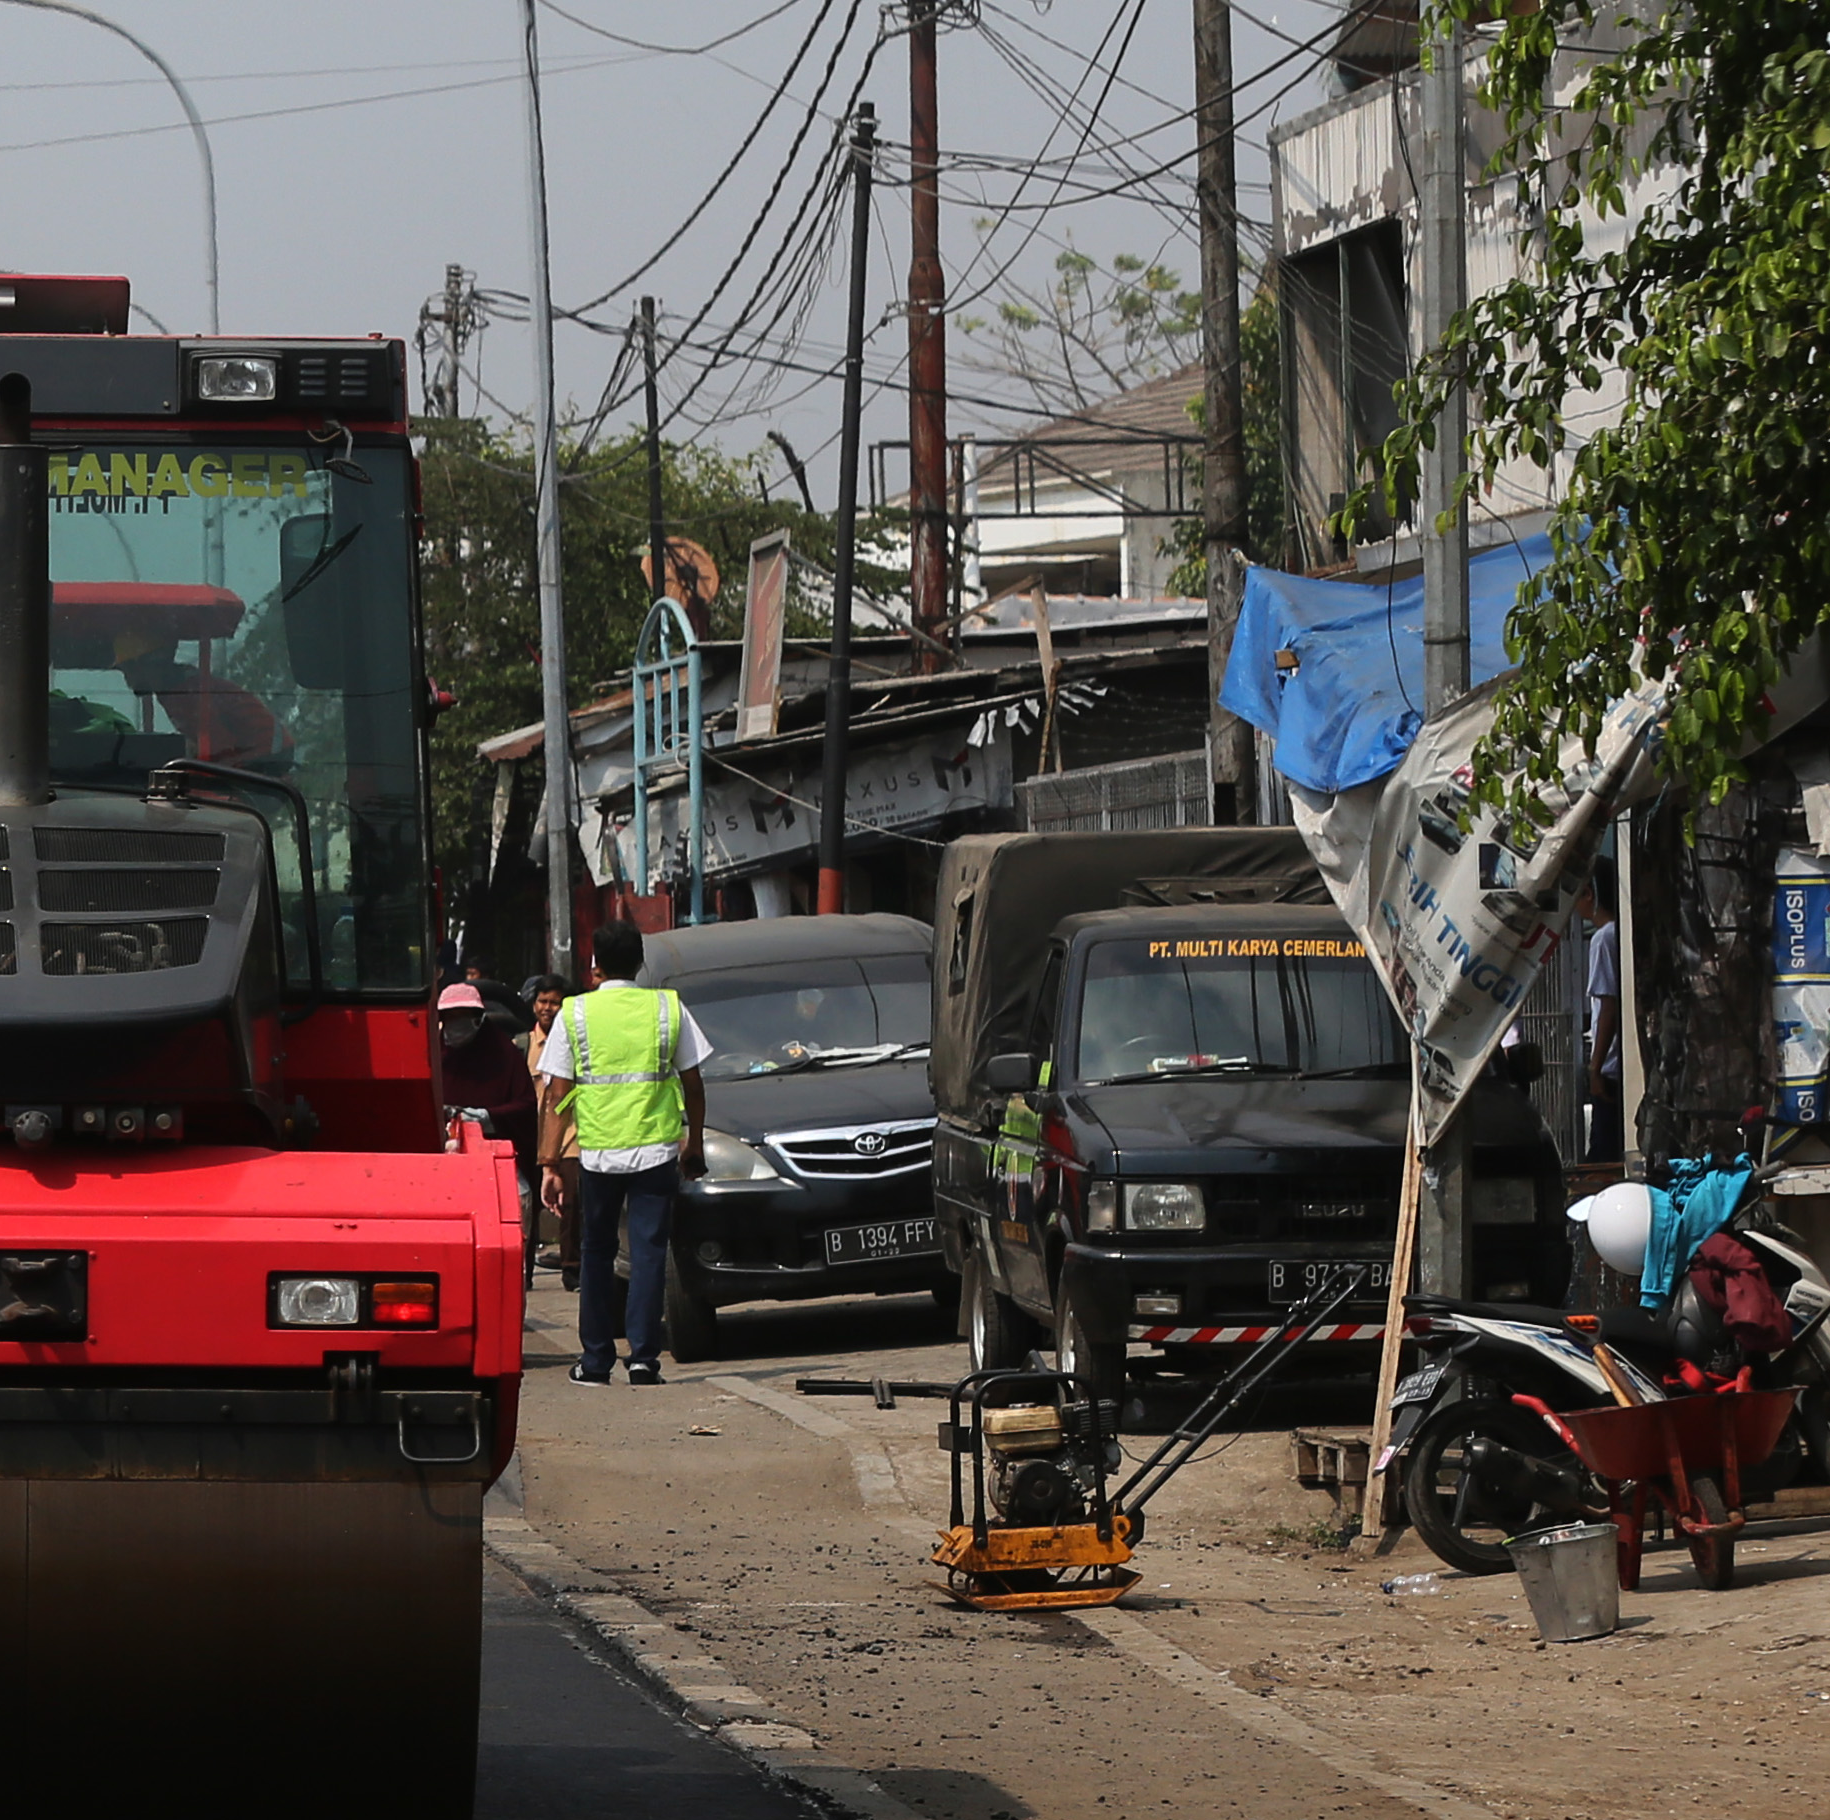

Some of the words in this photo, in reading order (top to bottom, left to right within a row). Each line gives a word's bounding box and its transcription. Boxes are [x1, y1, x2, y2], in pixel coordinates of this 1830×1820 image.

[1786, 889, 1805, 969] ISOPLUS
[1149, 941, 1171, 958] PT.
[1175, 940, 1223, 958] MULTI
[1227, 939, 1279, 957] KARYA
[1282, 939, 1367, 958] CEMERLAN
[1436, 914, 1524, 1010] TINGGI
[1302, 1204, 1365, 1217] ISUZU
[831, 1232, 842, 1252] B
[858, 1225, 898, 1250] 1394
[904, 1221, 934, 1244] FFY
[1272, 1264, 1284, 1288] B
